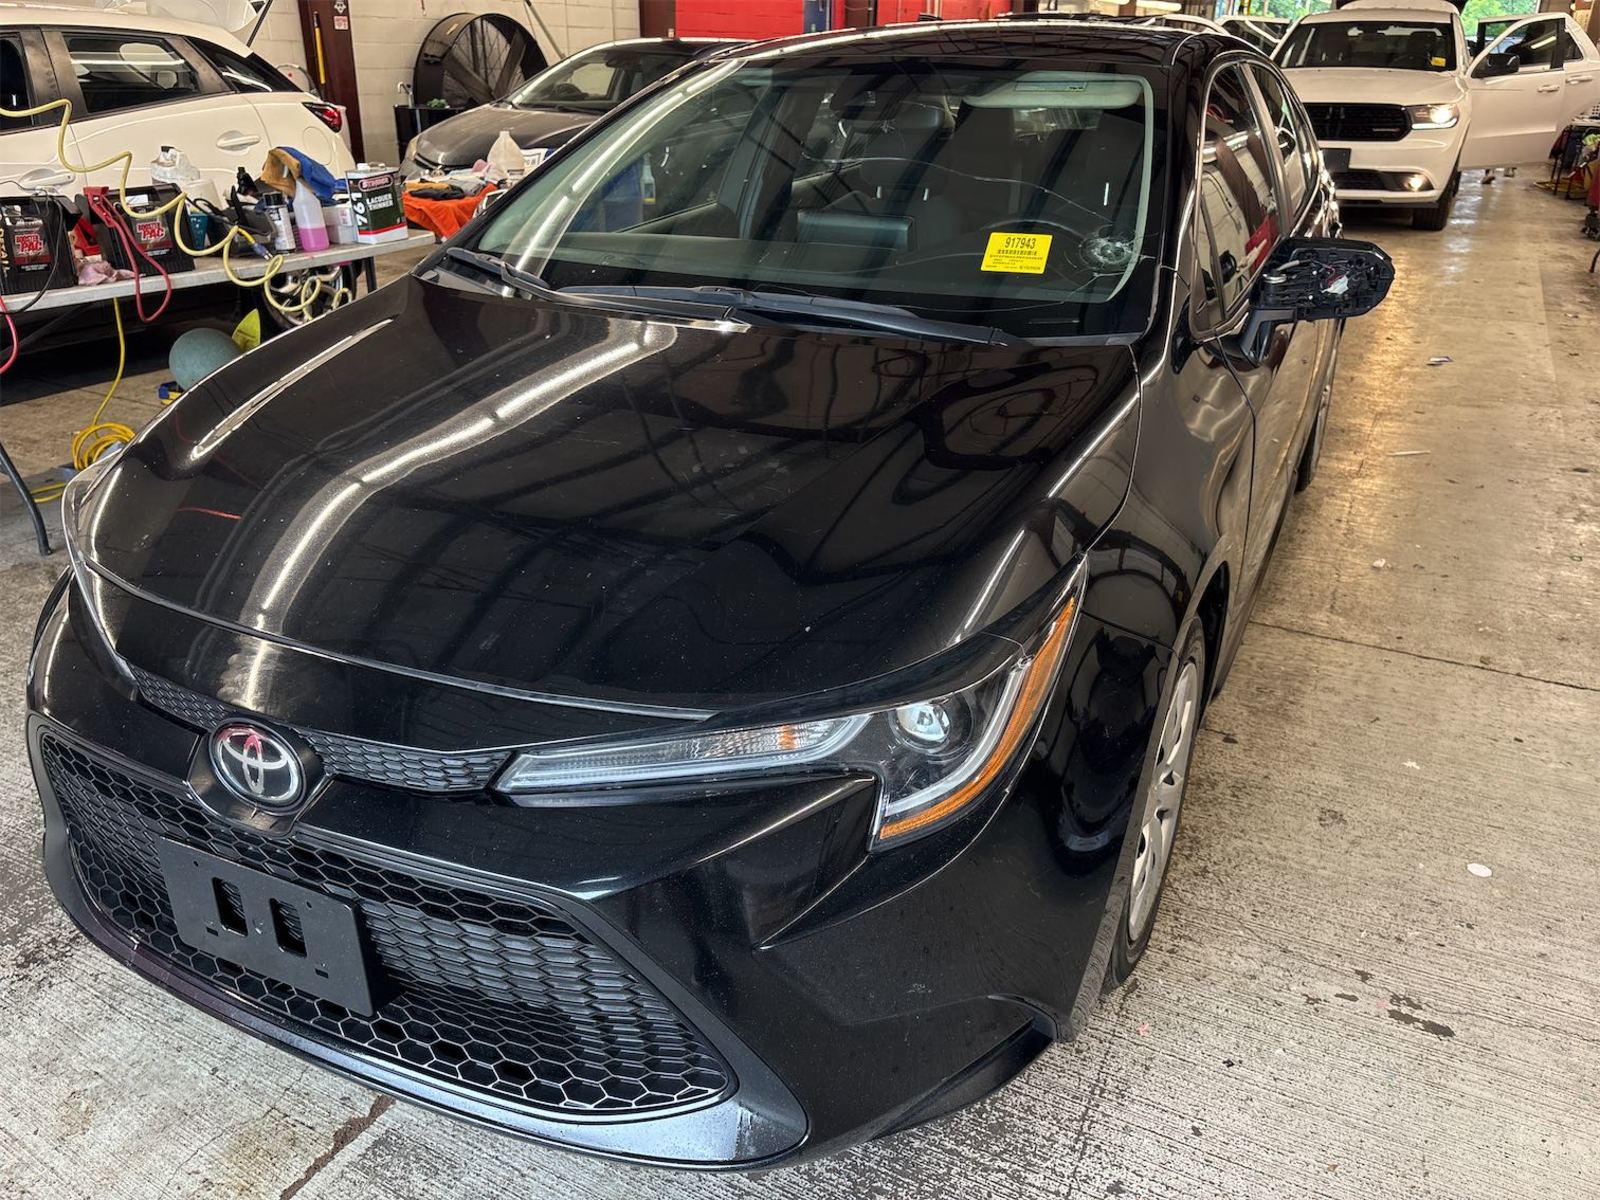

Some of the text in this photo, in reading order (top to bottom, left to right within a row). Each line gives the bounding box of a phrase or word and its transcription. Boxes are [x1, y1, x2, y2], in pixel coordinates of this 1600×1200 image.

[366, 193, 391, 204] LACQUER
[351, 192, 368, 225] 761
[368, 199, 392, 210] THINNER
[142, 228, 166, 239] PAC
[18, 241, 42, 253] PAC
[1004, 237, 1037, 249] 917943
